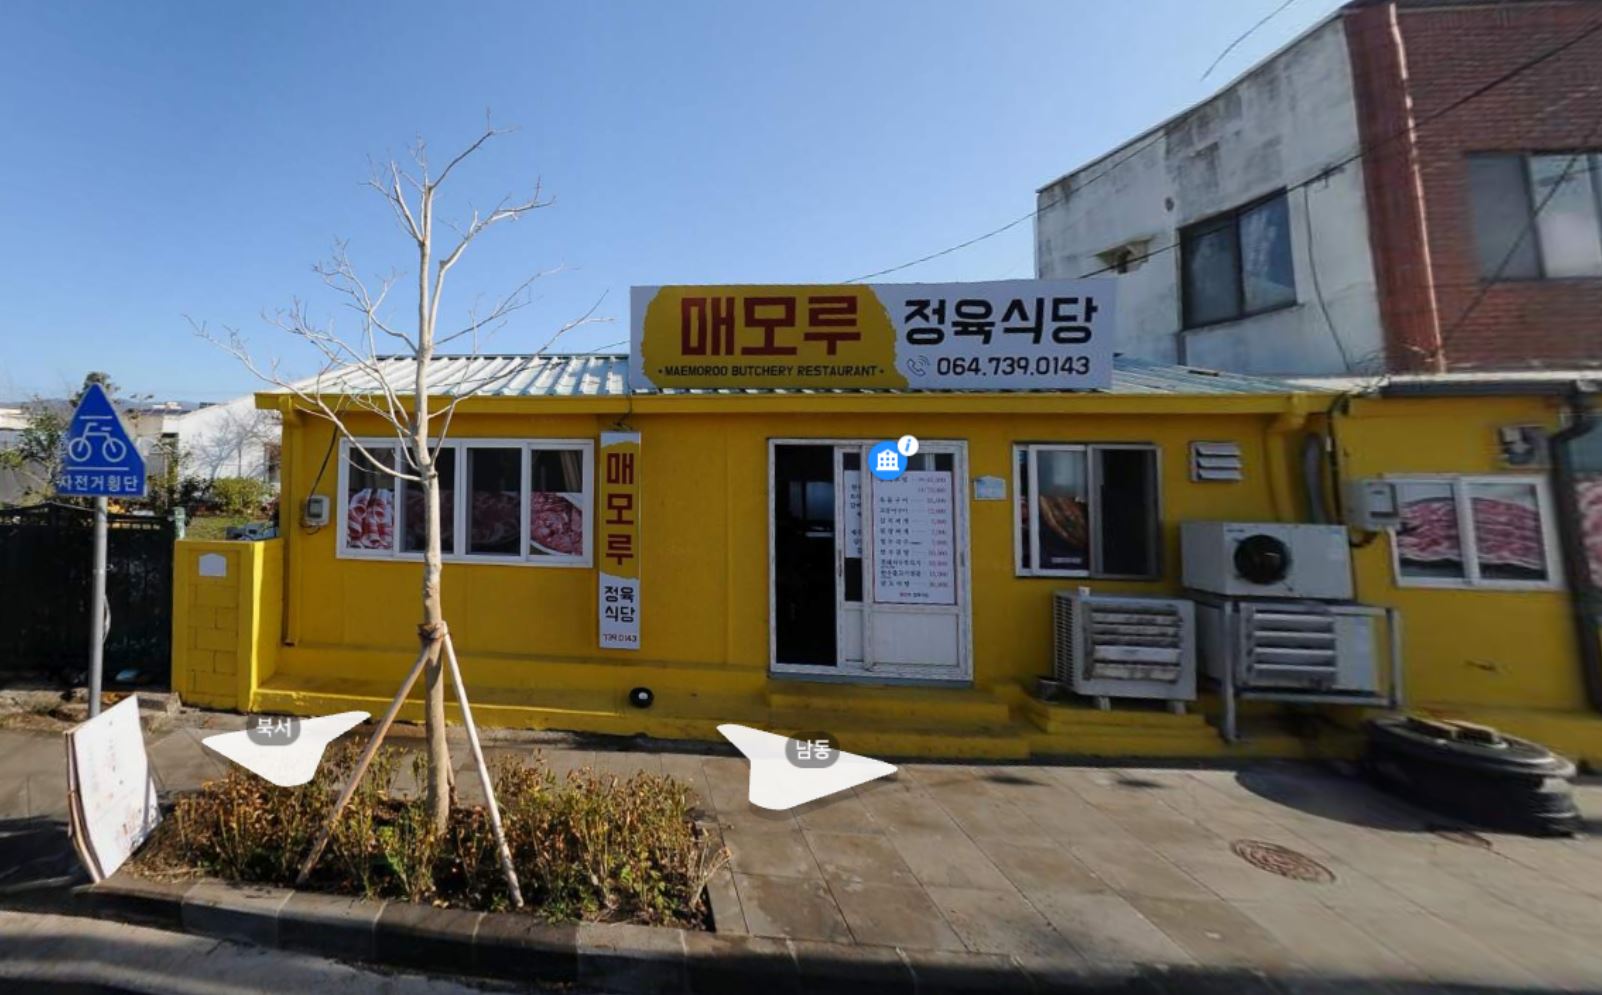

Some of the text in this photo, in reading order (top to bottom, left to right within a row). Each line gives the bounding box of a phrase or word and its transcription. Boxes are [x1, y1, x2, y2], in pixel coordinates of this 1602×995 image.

[681, 295, 862, 357] 매모루
[904, 296, 1098, 346] 정육식당
[664, 364, 877, 377] MAEMOROO BUTCHERY RESTAURANT
[936, 356, 1090, 377] 064.739.0143
[58, 474, 139, 492] 자전거횡단
[606, 453, 634, 566] 매모루
[604, 585, 635, 603] 정육
[604, 605, 636, 622] 식당
